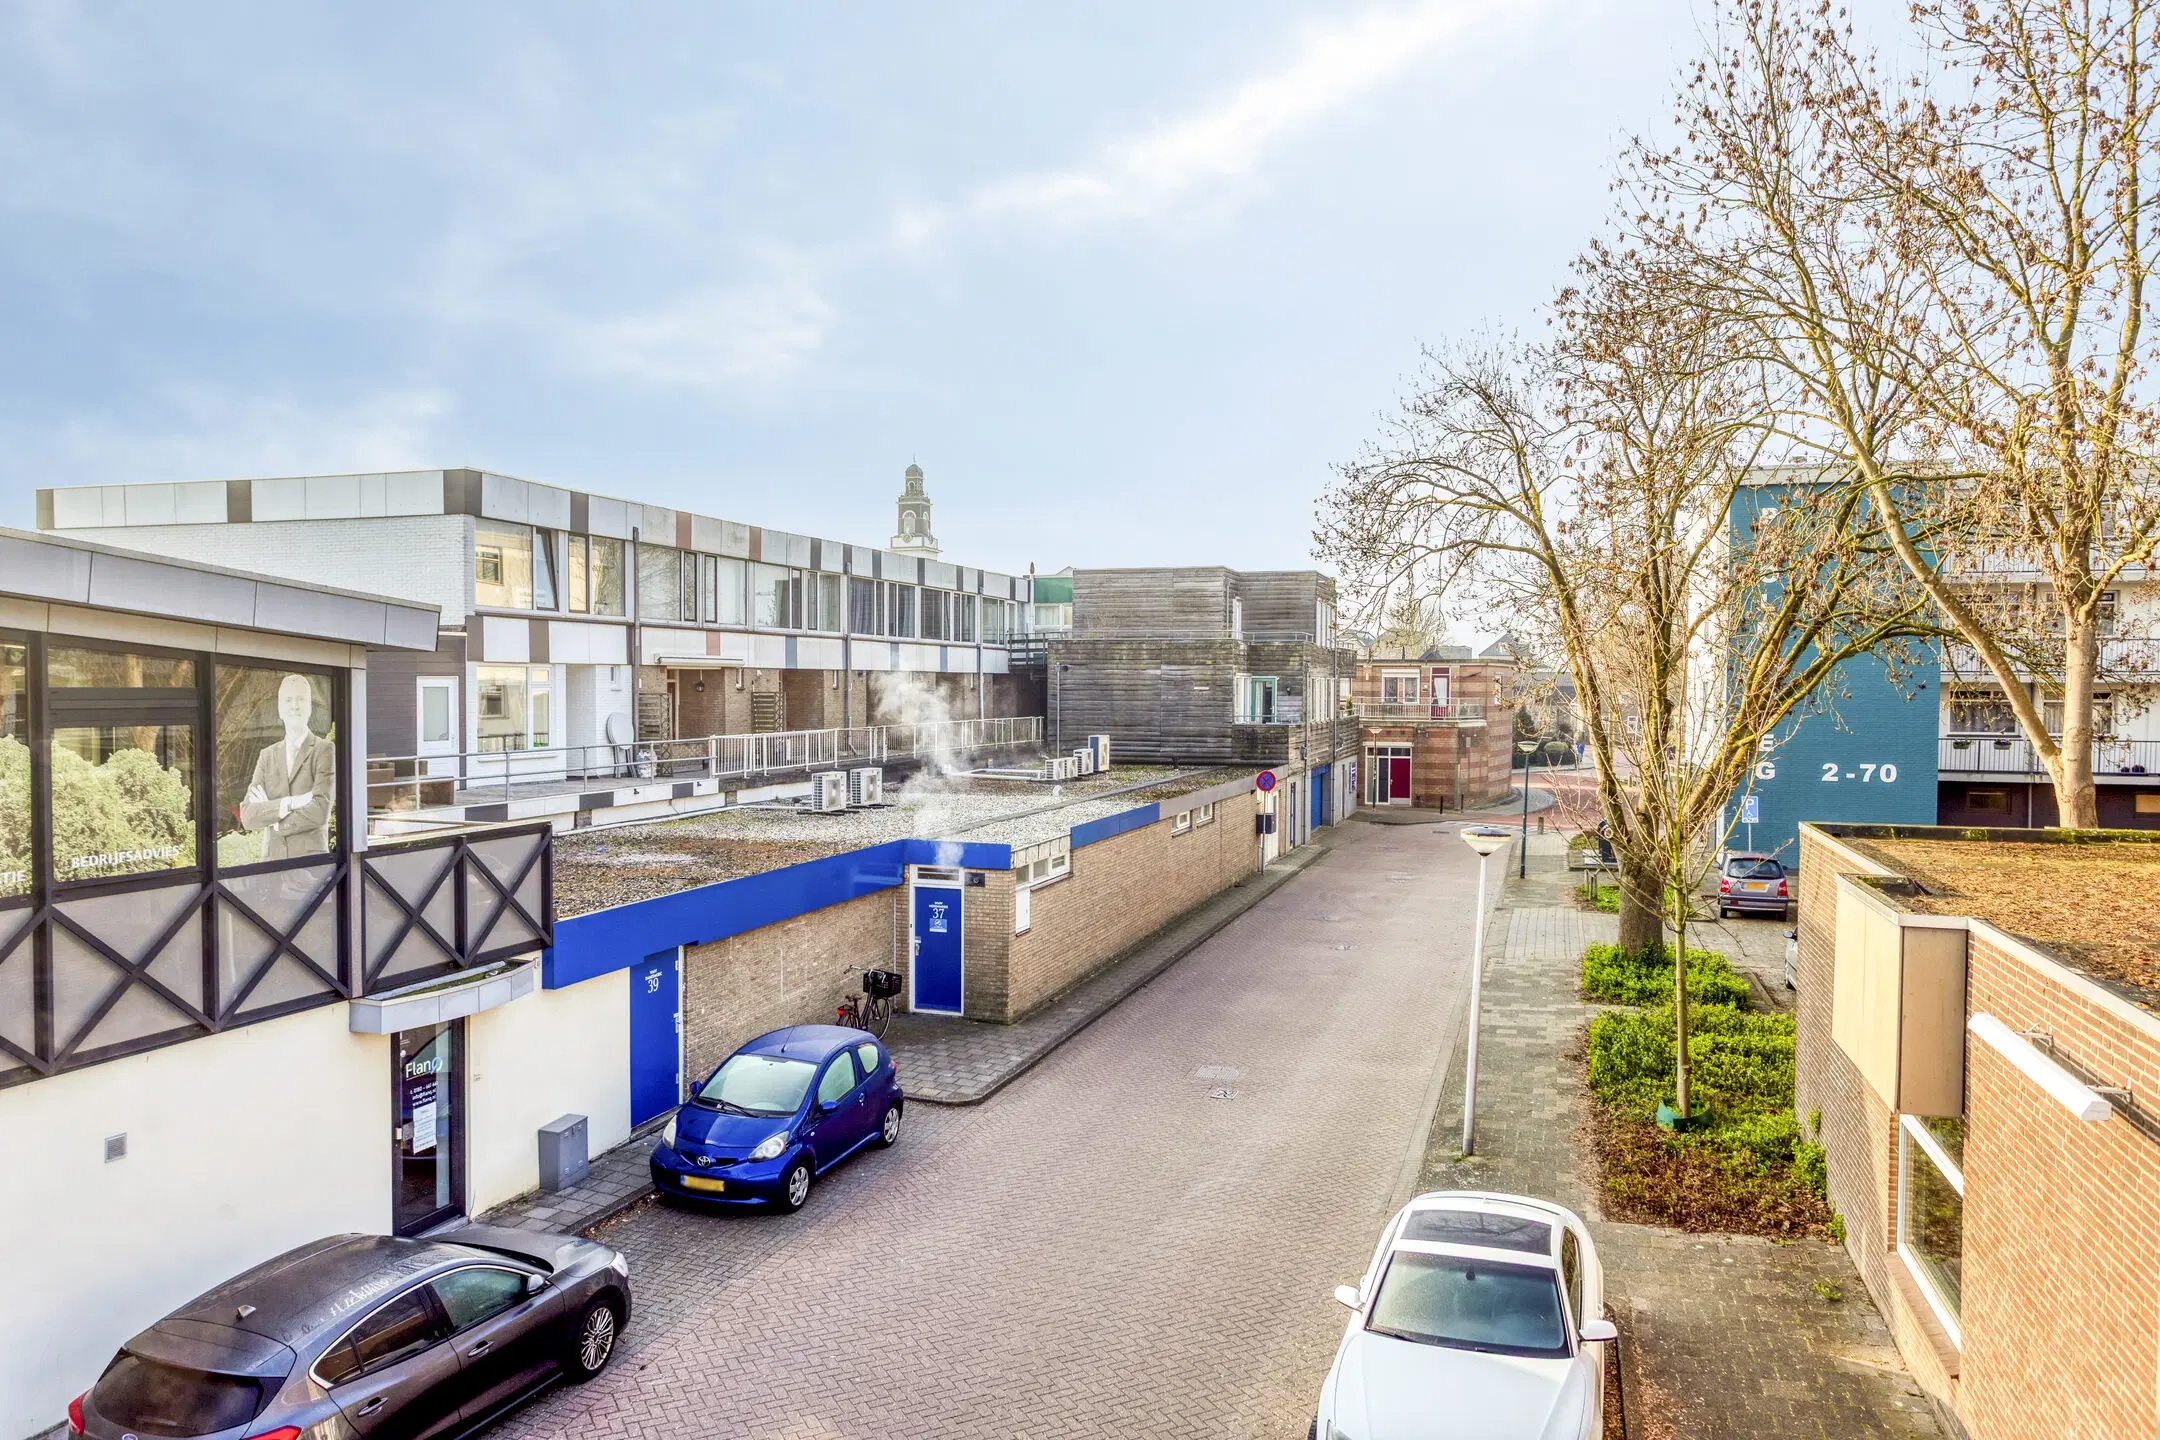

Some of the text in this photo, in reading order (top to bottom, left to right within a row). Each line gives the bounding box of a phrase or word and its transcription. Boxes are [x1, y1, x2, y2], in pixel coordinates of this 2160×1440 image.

[1821, 762, 1897, 783] 2-70
[1746, 799, 1754, 810] P
[71, 845, 180, 869] BEDRIJFSADVIES
[932, 907, 945, 919] 37
[647, 977, 659, 994] 39
